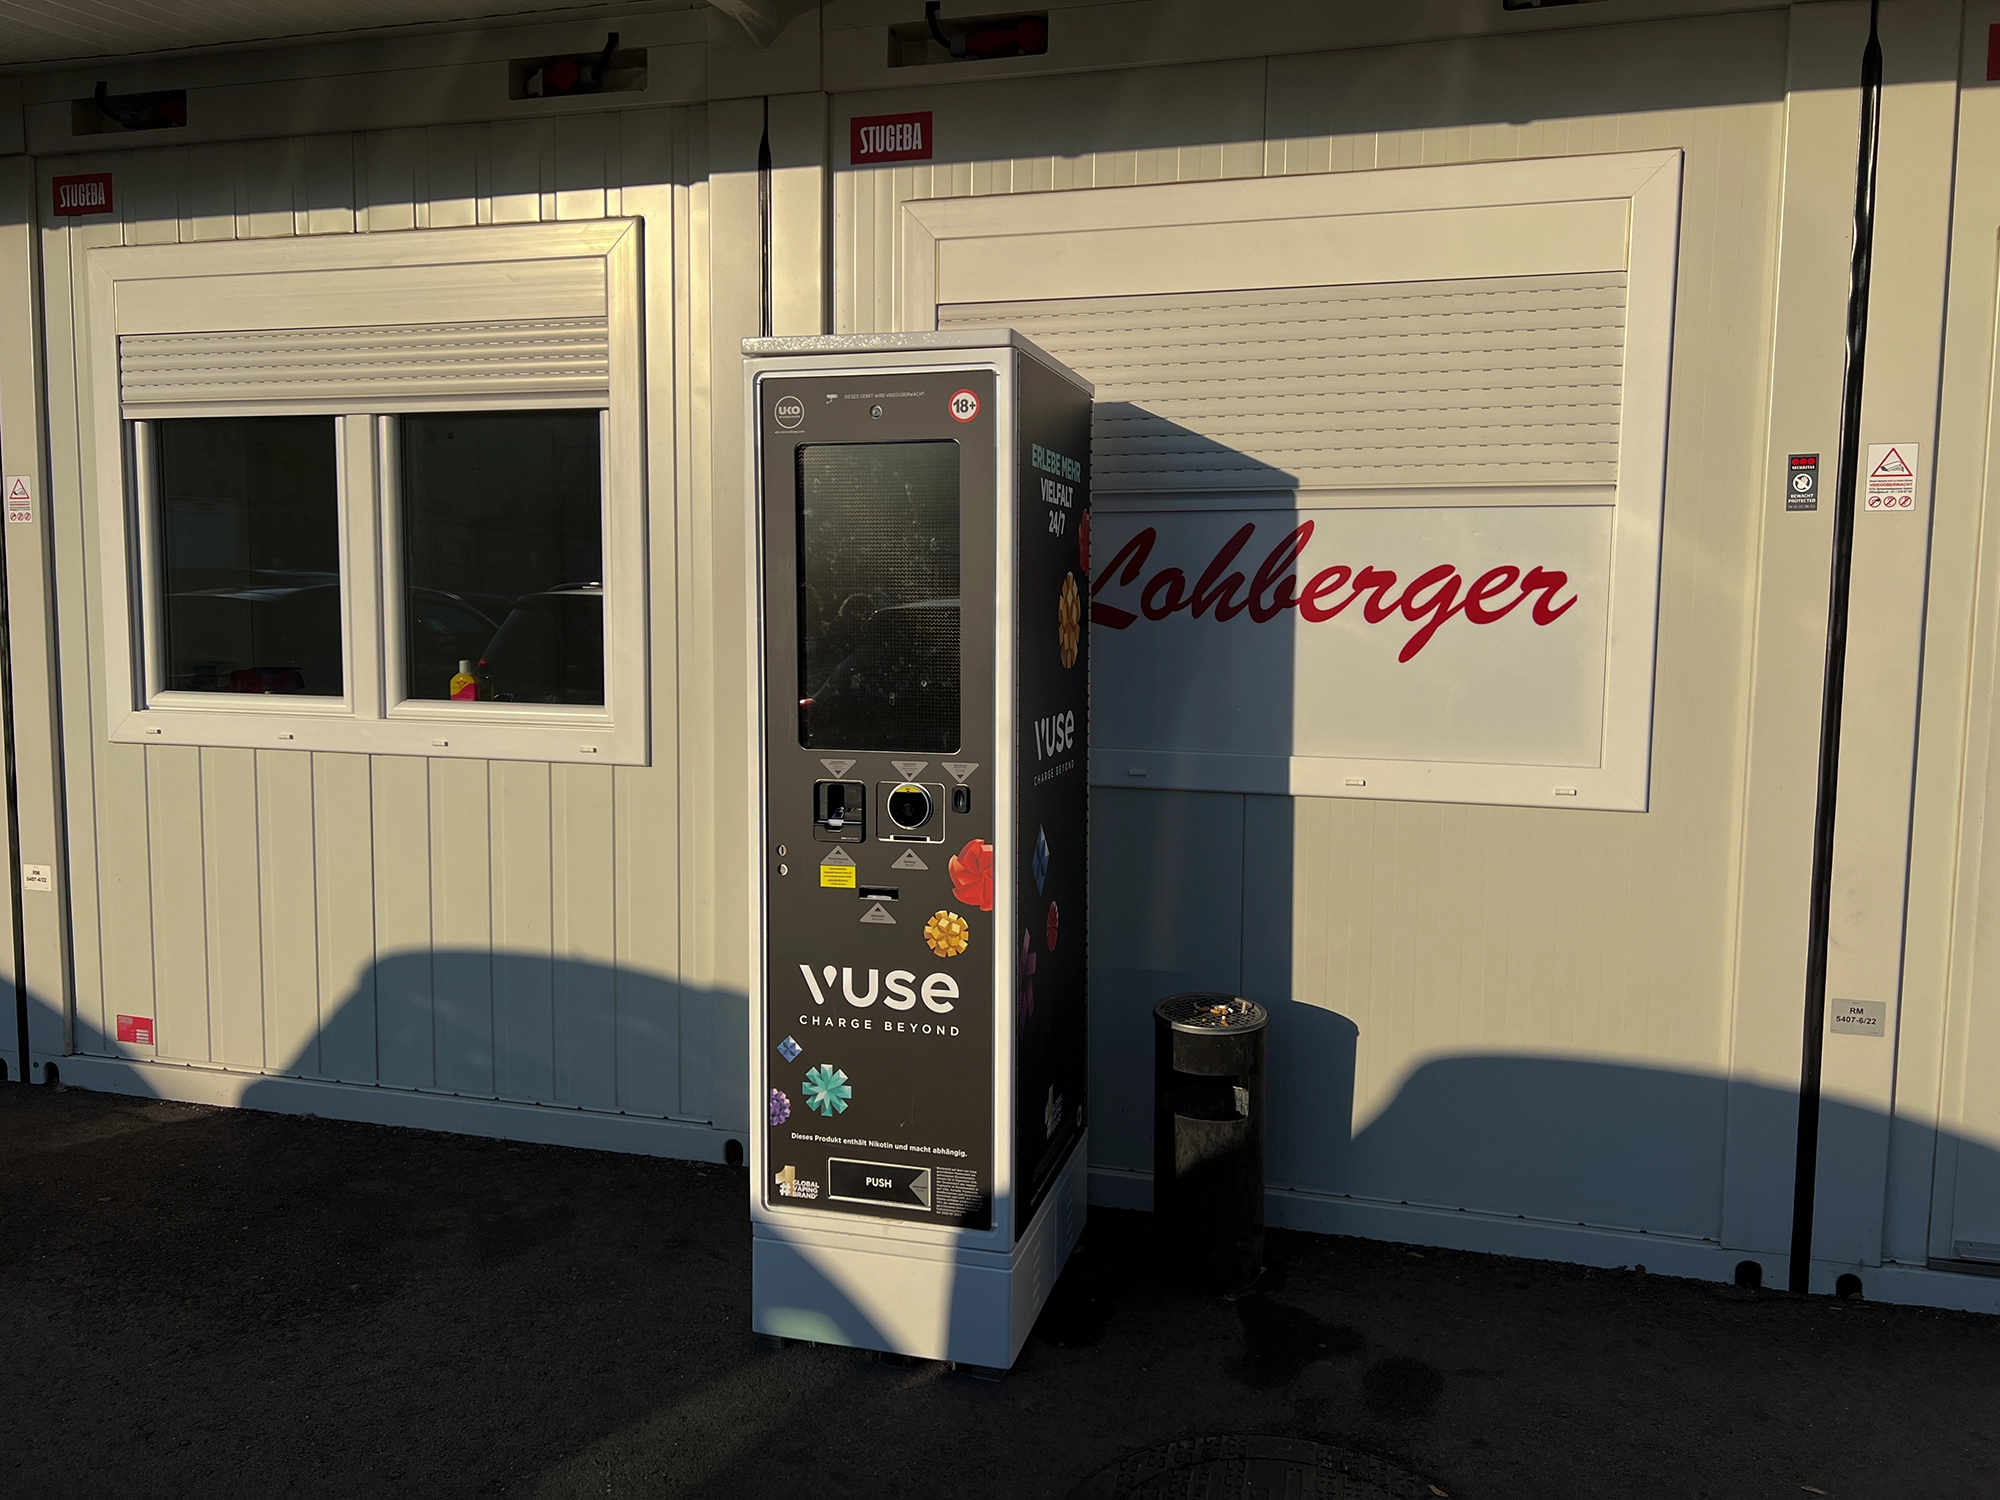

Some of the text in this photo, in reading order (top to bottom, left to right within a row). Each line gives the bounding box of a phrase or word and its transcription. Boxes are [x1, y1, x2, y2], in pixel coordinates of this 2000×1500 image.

[860, 122, 922, 154] STUGEBA
[60, 182, 105, 208] STUGEBA
[953, 399, 976, 413] 18+
[1032, 443, 1081, 483] ERLEBE MEHR
[1040, 477, 1074, 508] VIELFALT
[1048, 509, 1066, 537] 24/7
[1091, 519, 1578, 664] Lohberger
[1034, 759, 1075, 786] CHARGE BEYOND
[1836, 1015, 1877, 1025] 5407-6/22
[1849, 1007, 1864, 1015] RM
[799, 1014, 960, 1037] CHARGE BEYOND
[791, 1132, 968, 1158] Dieses Produkt enthält Nikotin und macht abhängig.
[792, 1179, 820, 1189] GLOBAL
[792, 1185, 818, 1194] VAPING
[866, 1177, 892, 1188] PUSH
